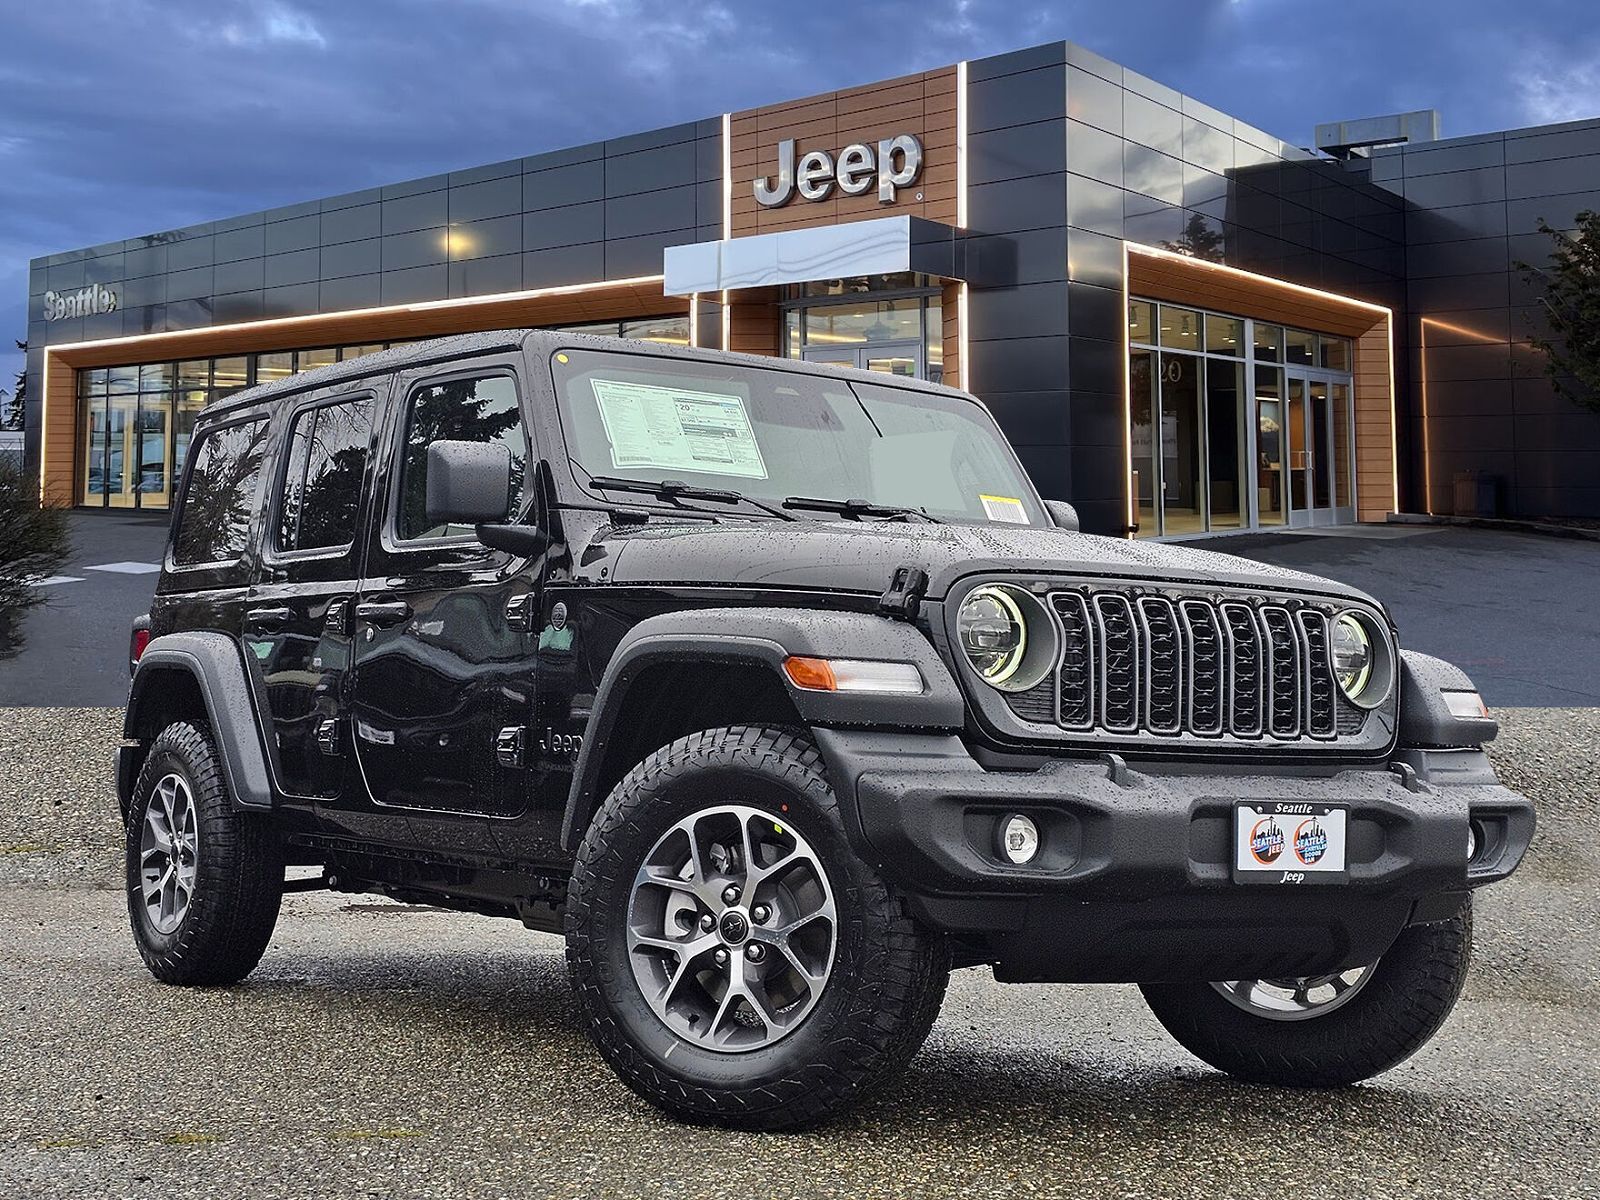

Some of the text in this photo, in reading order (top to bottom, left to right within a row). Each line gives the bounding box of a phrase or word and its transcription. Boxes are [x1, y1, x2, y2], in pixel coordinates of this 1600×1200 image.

[752, 133, 923, 209] Jeep
[43, 283, 114, 322] Seattle
[539, 727, 584, 758] Jeep
[1275, 803, 1313, 814] Seattle
[1252, 835, 1282, 849] SEATTLE
[1296, 835, 1325, 849] SEATTLE
[1268, 842, 1284, 857] JEEP
[1280, 871, 1305, 884] Jeep
